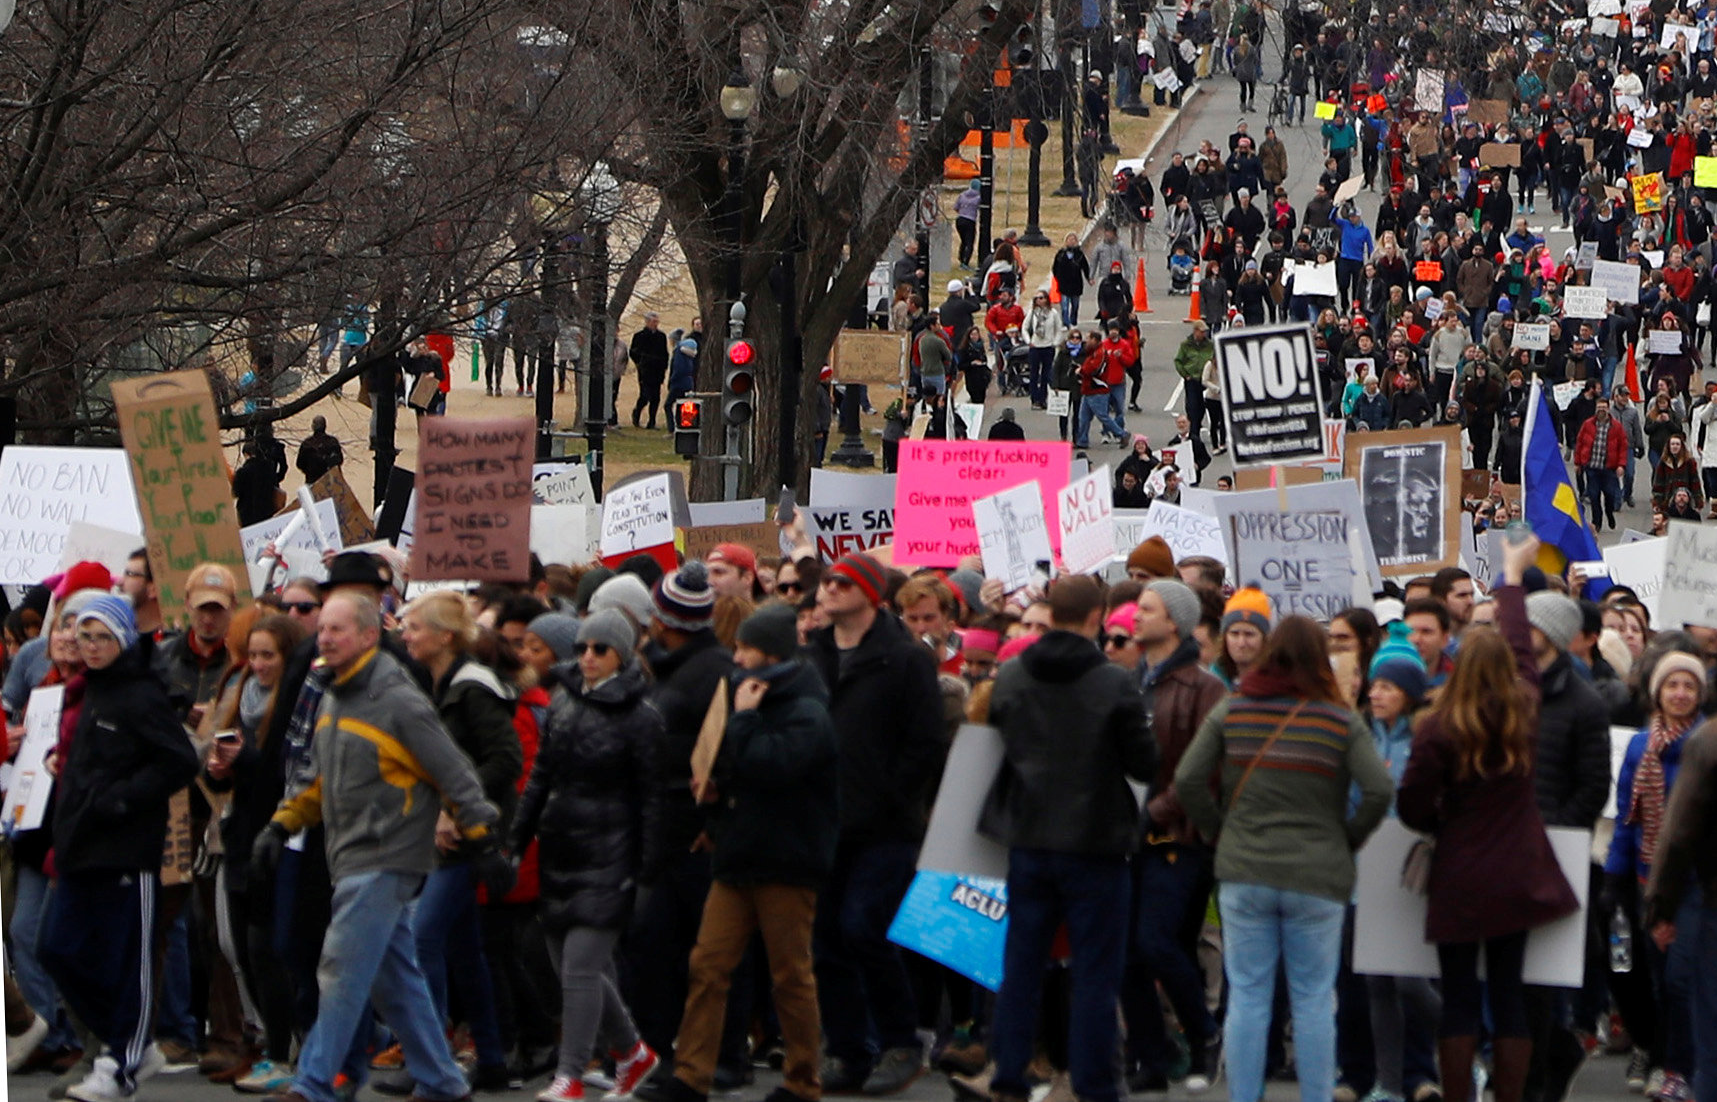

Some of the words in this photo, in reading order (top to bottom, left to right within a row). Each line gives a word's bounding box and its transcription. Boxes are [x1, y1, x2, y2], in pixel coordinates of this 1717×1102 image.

[1225, 334, 1310, 404] NO!
[1232, 409, 1255, 422] STOP
[426, 430, 468, 449] HOW
[473, 428, 526, 448] MANY
[423, 455, 523, 478] PROTEST
[911, 448, 935, 461] It's
[942, 450, 989, 466] pretty
[994, 450, 1048, 467] fucking
[10, 461, 46, 490] NO
[958, 465, 1005, 480] clear:
[423, 484, 497, 507] SIGNS
[502, 482, 532, 499] DO
[546, 477, 577, 497] POINT
[1066, 480, 1096, 509] NO
[2, 494, 32, 519] NO
[634, 502, 651, 514] THE
[908, 492, 941, 507] Give
[944, 496, 967, 507] me
[424, 513, 444, 534] I
[450, 513, 510, 530] NEED
[814, 511, 853, 531] WE
[949, 516, 976, 531] you
[1062, 499, 1110, 535] WALL
[1153, 508, 1221, 540] NATSEC
[1238, 511, 1348, 544] OPPRESSION
[627, 530, 635, 550] ?
[816, 535, 893, 561] NEVE
[907, 541, 941, 556] your
[426, 551, 510, 573] MAKE
[1261, 558, 1321, 582] ONE
[951, 883, 1006, 921] ACLU
